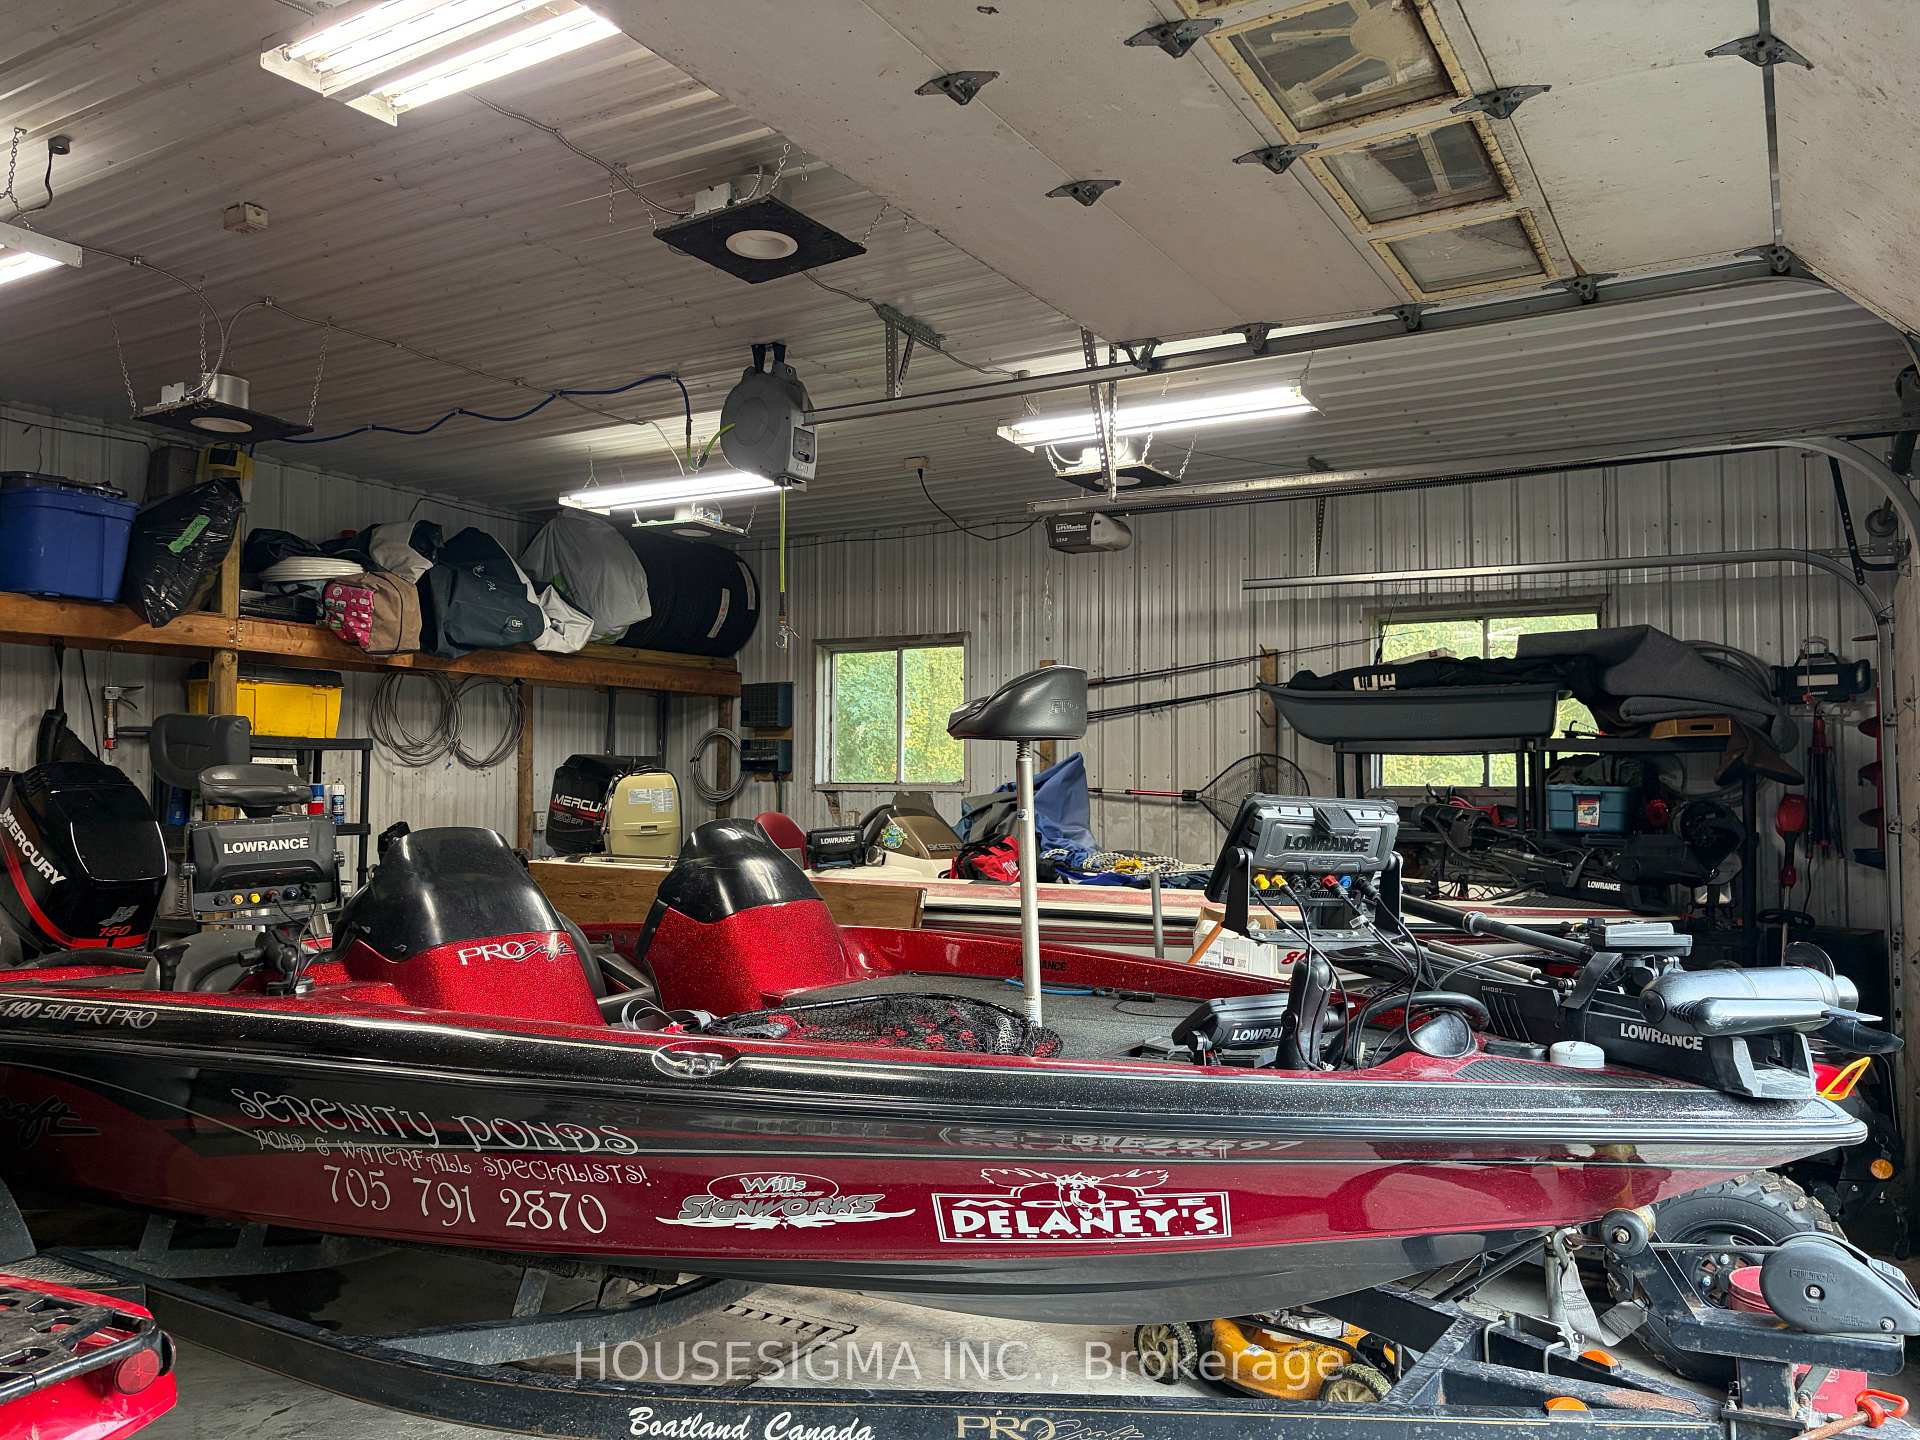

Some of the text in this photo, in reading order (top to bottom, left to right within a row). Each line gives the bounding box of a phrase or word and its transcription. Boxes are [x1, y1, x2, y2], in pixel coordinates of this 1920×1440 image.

[554, 793, 602, 813] MERCU
[0, 807, 67, 885] MERCURY
[223, 837, 309, 854] LOWRANCE
[820, 835, 856, 845] LOWRANCE
[1284, 835, 1371, 852] LOWRANCE
[1587, 880, 1621, 891] LOWRANCE
[98, 925, 132, 937] 150
[38, 1003, 107, 1025] SUPER
[106, 1008, 158, 1029] PRO
[1620, 1022, 1704, 1051] LOWRANCE
[231, 1090, 639, 1155] SERENITY PONDS
[253, 1129, 306, 1152] POND
[337, 1139, 472, 1175] WATERFALL
[482, 1156, 652, 1187] SPECIALISTS!
[739, 1175, 807, 1193] Wills
[323, 1164, 608, 1234] 705 791 2870
[678, 1194, 886, 1220] SIGNWORKS
[951, 1207, 1218, 1235] DELANEY'S
[628, 1406, 876, 1440] Boatland Canada
